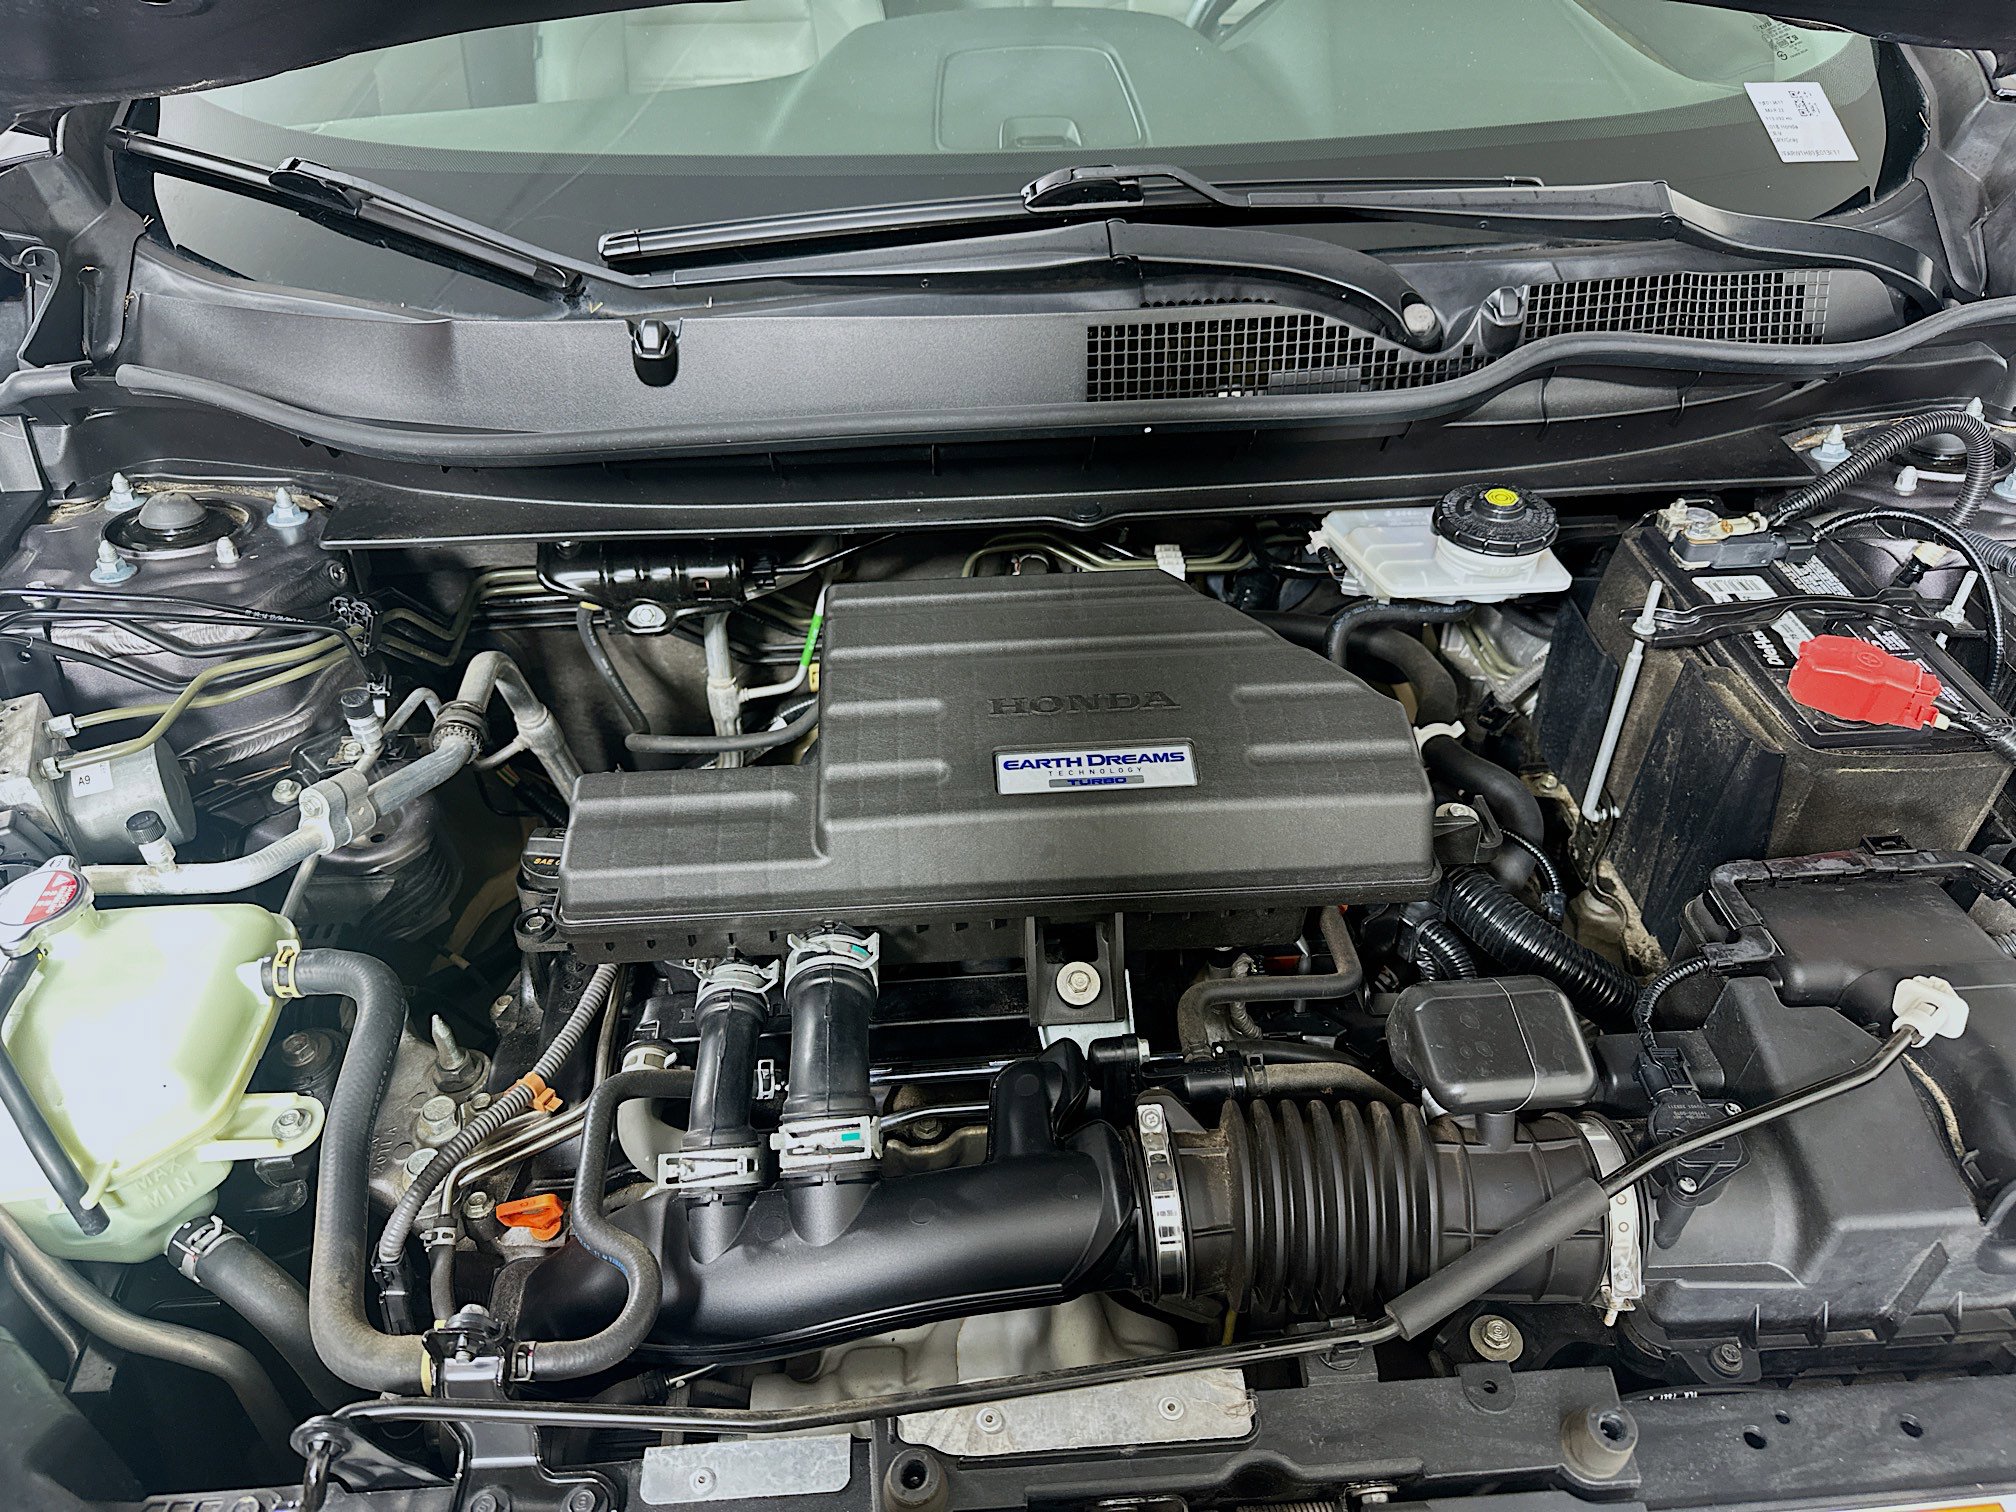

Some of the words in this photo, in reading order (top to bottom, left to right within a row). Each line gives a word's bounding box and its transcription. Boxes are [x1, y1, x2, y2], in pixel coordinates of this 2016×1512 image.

[987, 690, 1181, 718] HONDA
[1003, 757, 1083, 771] EARTH
[1087, 752, 1186, 767] DREAMS
[1048, 766, 1143, 776] TECHNOLOGY
[79, 775, 91, 787] A9
[1066, 777, 1127, 787] TURBO
[533, 858, 555, 866] SAE
[135, 1157, 184, 1191] MAX
[144, 1169, 196, 1209] MIN
